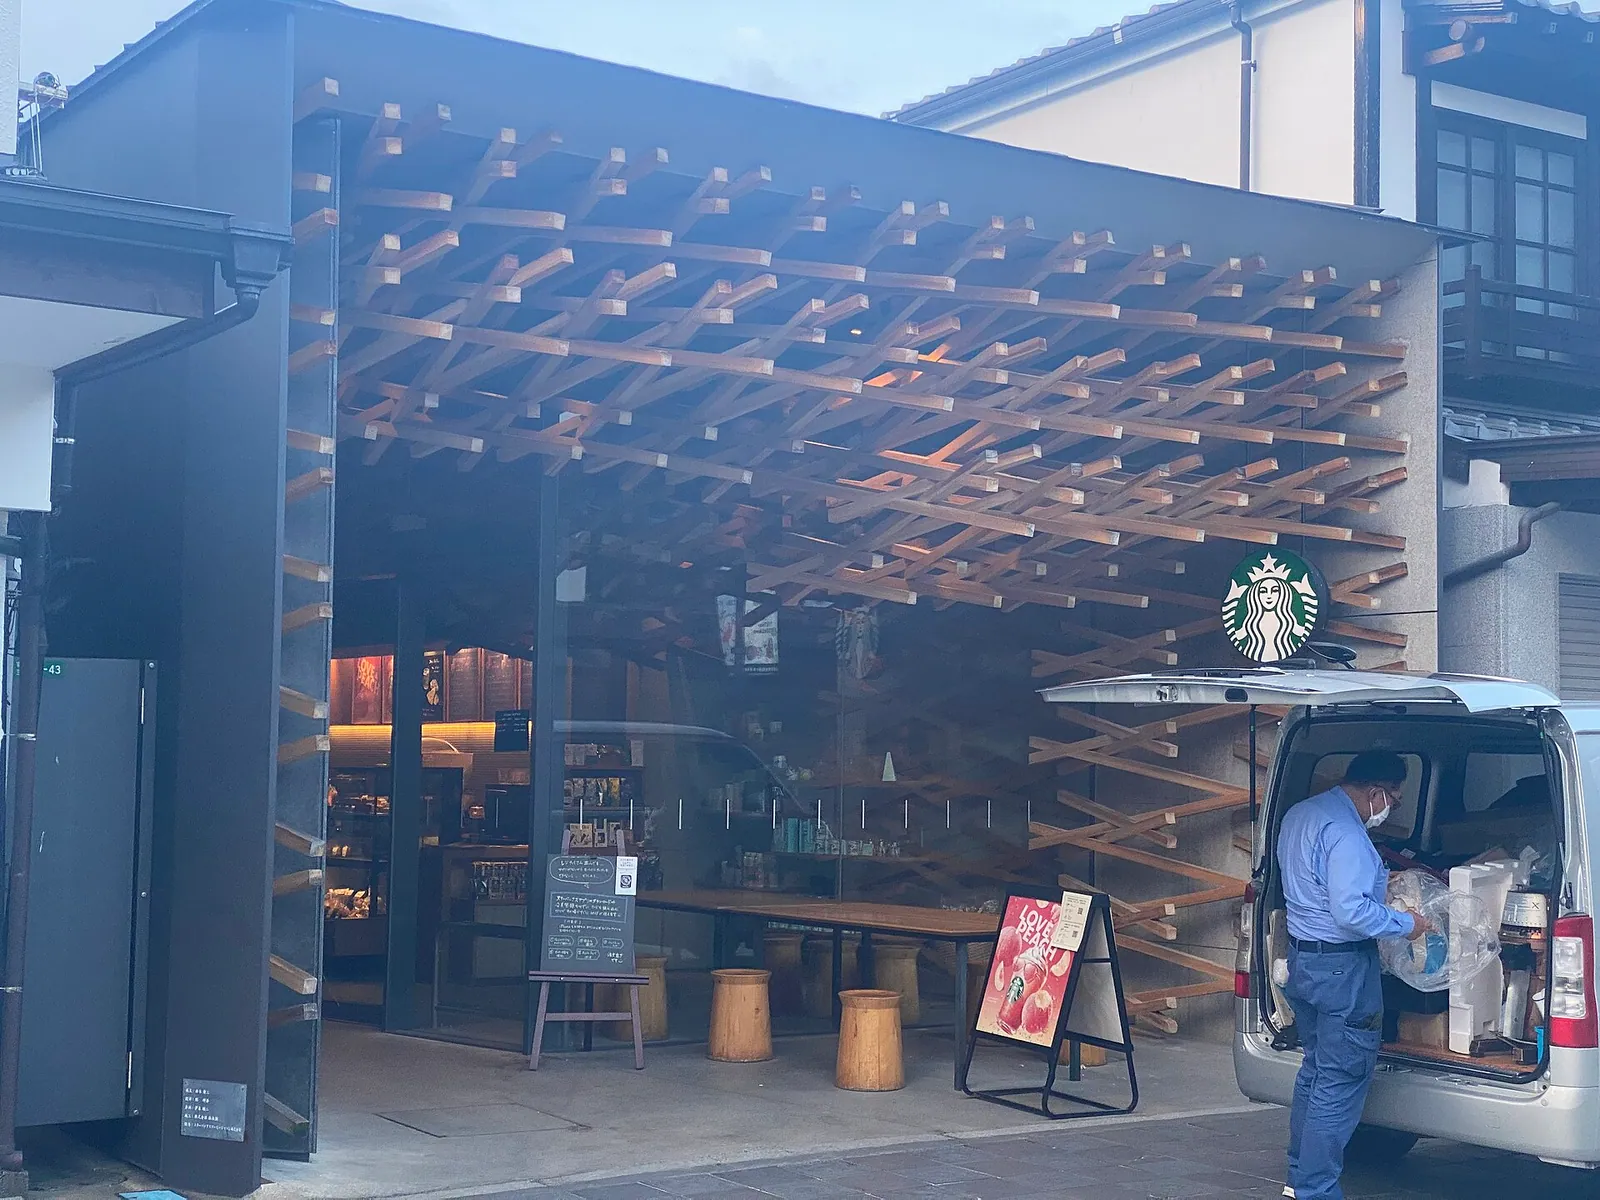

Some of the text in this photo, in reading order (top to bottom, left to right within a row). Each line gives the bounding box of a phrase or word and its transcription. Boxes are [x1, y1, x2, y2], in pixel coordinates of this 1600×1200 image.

[358, 658, 375, 676] LOVE
[1019, 905, 1054, 938] LOVE
[1015, 919, 1057, 961] PEACH
